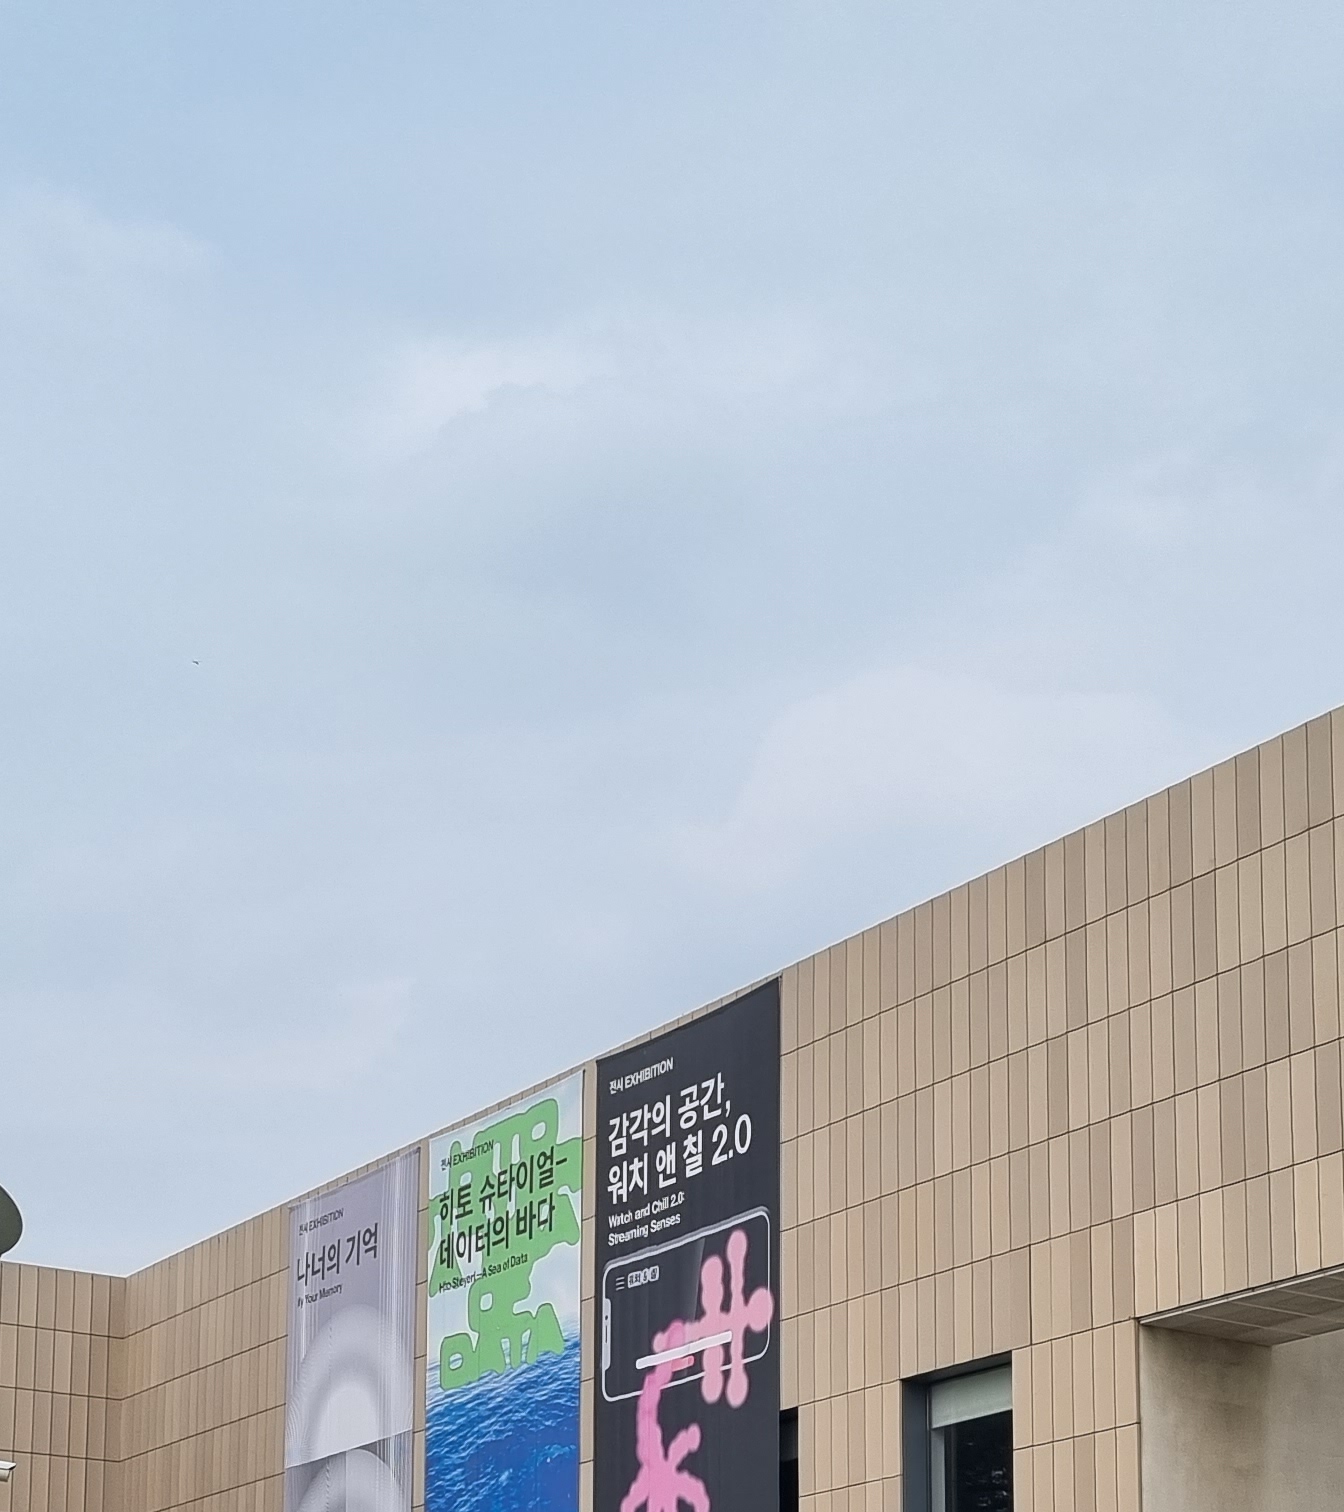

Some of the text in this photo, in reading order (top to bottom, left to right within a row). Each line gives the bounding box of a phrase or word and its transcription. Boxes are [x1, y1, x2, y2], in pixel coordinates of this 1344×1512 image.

[610, 1056, 674, 1094] 전시 EXHIBITION
[609, 1072, 731, 1157] 감각의 공간,
[453, 1139, 494, 1166] EXHIBITION
[608, 1113, 752, 1204] 워치 앤 칠 2.0
[440, 1183, 473, 1225] 히토
[608, 1209, 633, 1228] Watch
[635, 1203, 650, 1220] and
[652, 1196, 669, 1214] Chill
[440, 1192, 555, 1269] 데이터의 바다
[608, 1214, 681, 1246] Streaming Senses
[297, 1222, 378, 1286] 나너의 기억
[488, 1263, 501, 1277] Sea
[503, 1258, 510, 1271] of
[511, 1253, 528, 1267] Data
